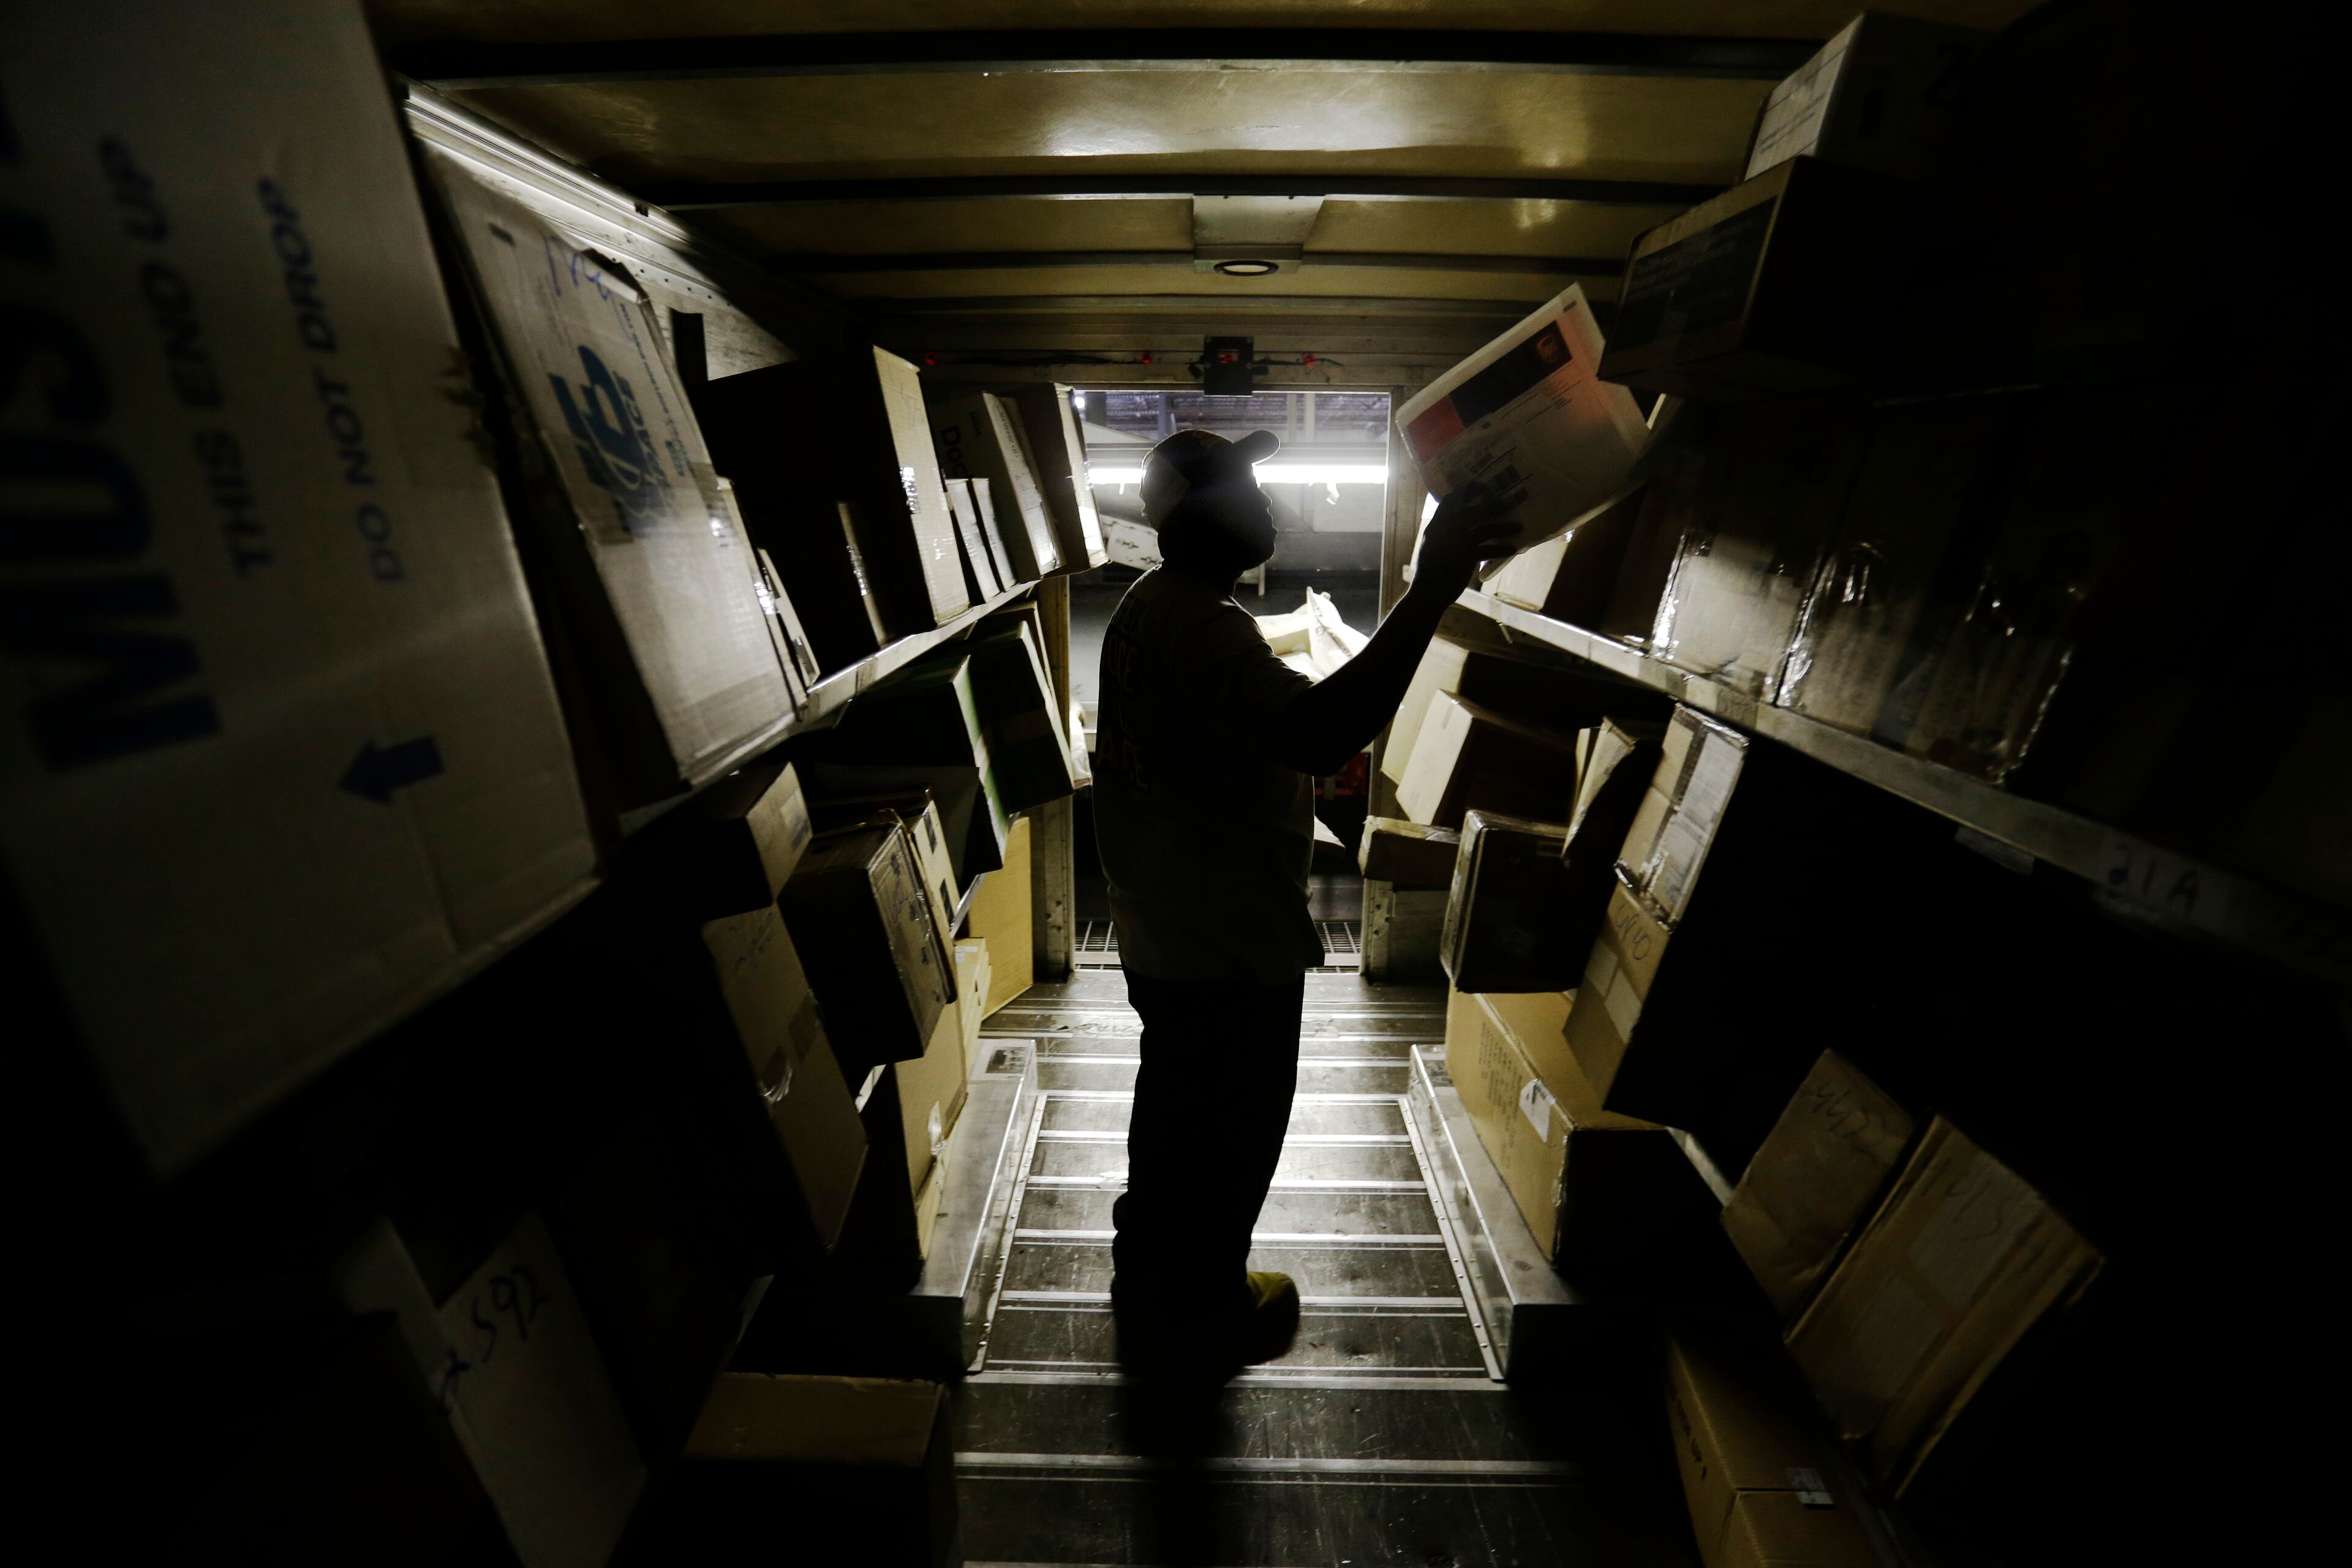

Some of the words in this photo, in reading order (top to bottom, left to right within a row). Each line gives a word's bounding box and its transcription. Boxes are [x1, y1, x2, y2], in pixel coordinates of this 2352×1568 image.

[98, 135, 168, 241] UP
[141, 260, 223, 409] END
[257, 177, 338, 353] DROP
[0, 92, 222, 775] MUS
[311, 369, 376, 486] NOT
[194, 431, 274, 577] THIS
[355, 502, 405, 582] DO
